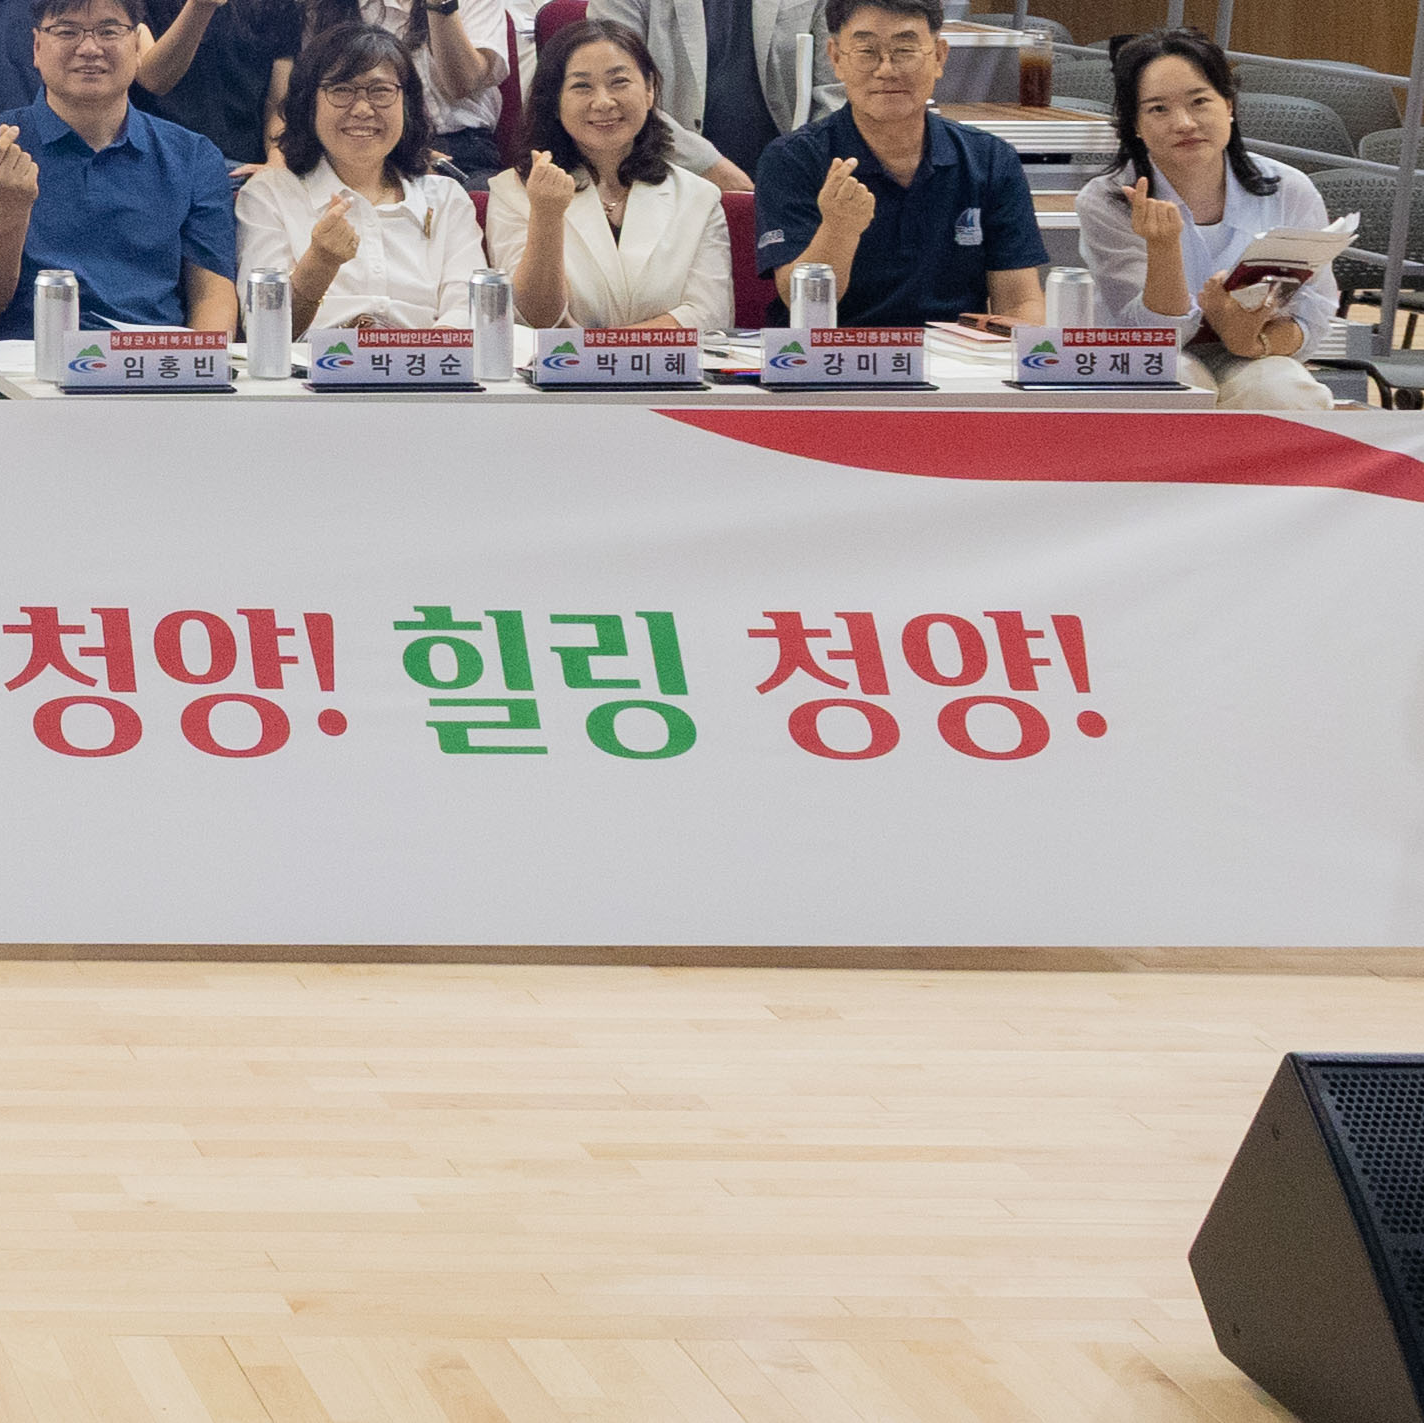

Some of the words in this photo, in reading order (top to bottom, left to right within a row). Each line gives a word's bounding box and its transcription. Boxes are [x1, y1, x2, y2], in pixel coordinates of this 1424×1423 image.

[124, 355, 215, 379] 임홍빈
[371, 353, 462, 376] 박경순
[597, 352, 686, 376] 박미혜
[823, 352, 911, 376] 강미희
[1075, 352, 1164, 376] 양재경
[3, 607, 349, 759] 청양!
[393, 605, 698, 761] 힐링
[747, 611, 1109, 762] 청양!
